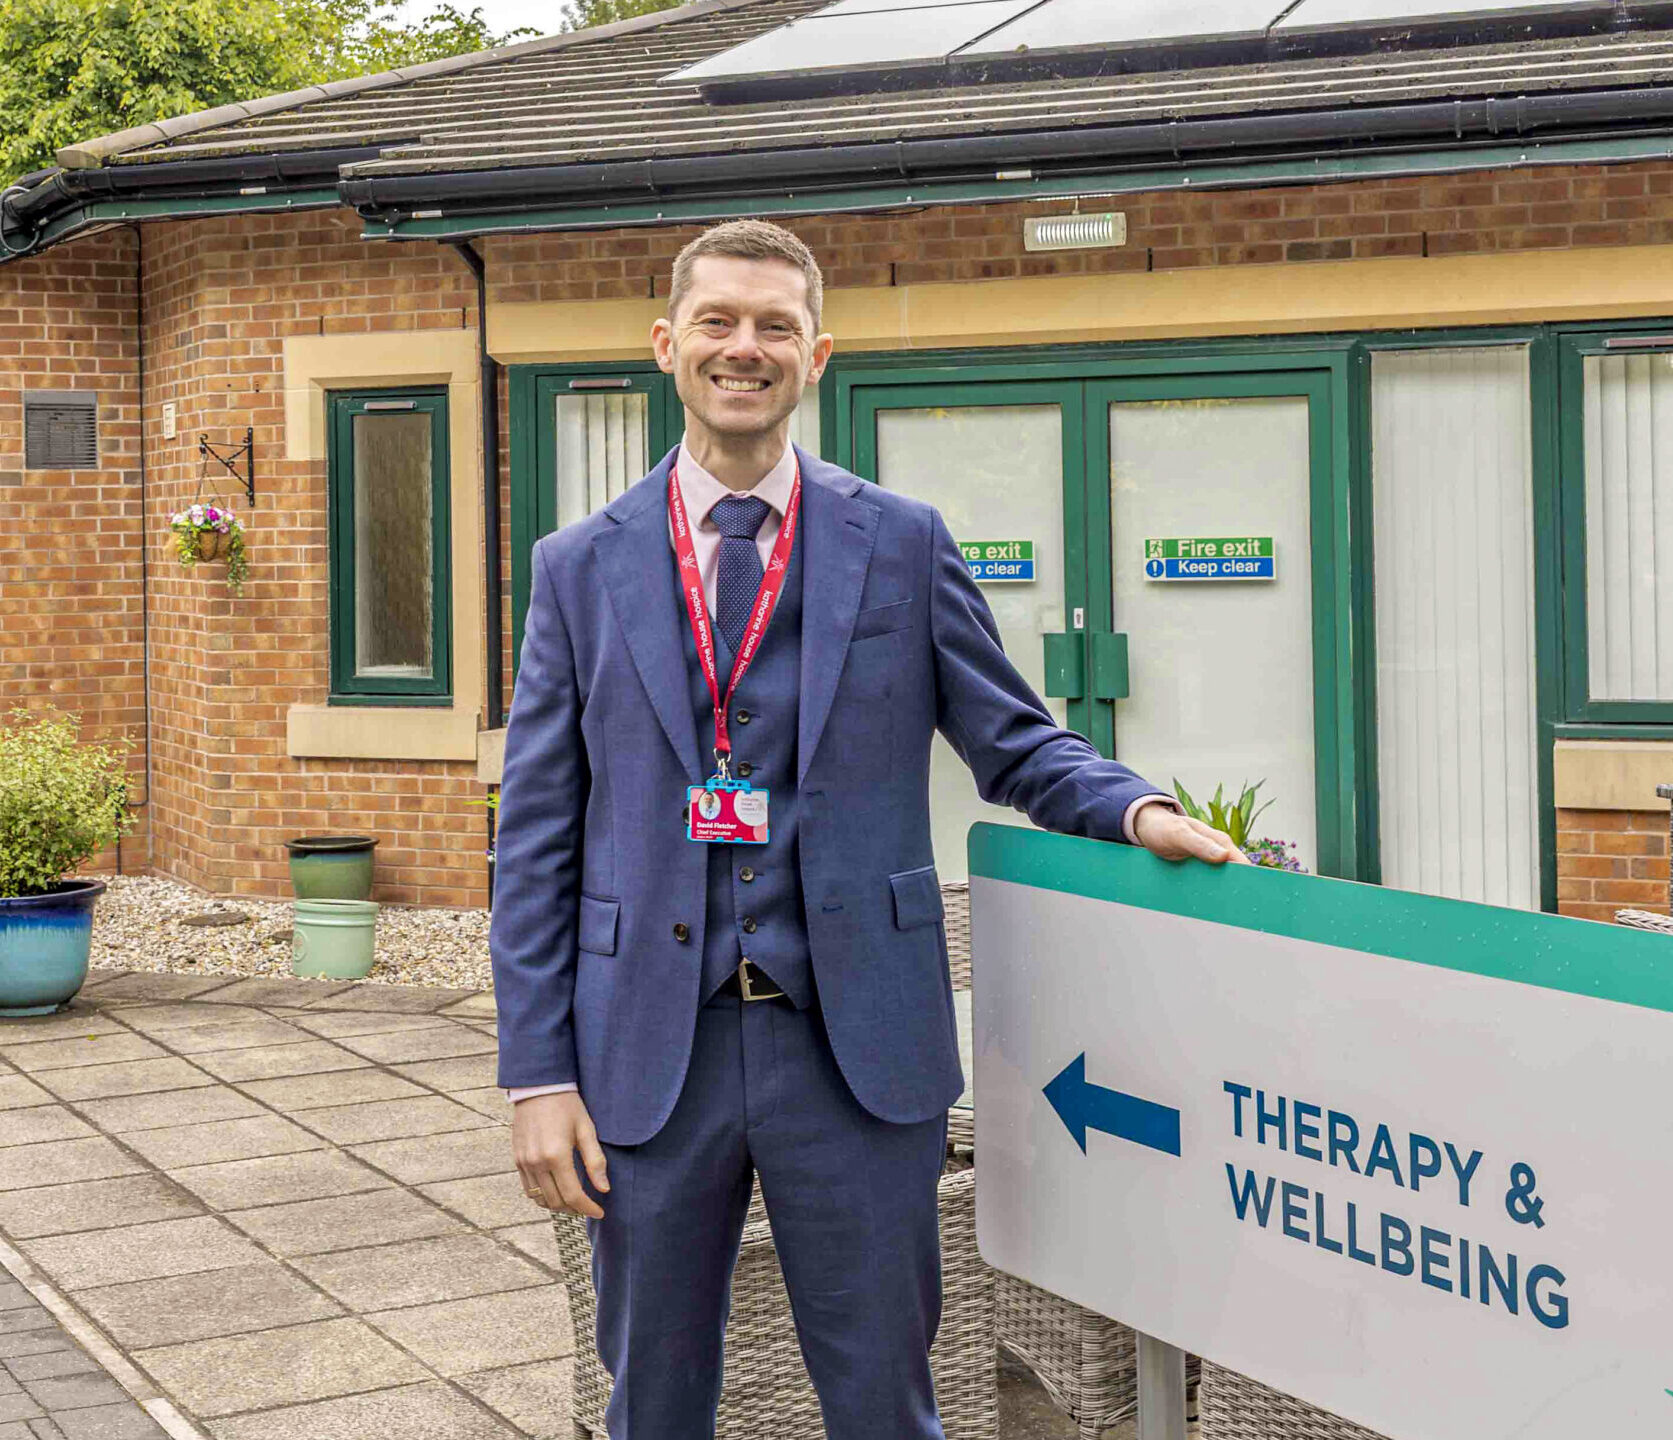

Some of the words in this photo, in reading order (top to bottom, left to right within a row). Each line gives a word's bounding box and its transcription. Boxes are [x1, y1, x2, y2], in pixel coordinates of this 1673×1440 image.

[957, 545, 980, 559] re
[986, 542, 1021, 559] exit
[1177, 540, 1217, 556] Fire
[1222, 538, 1261, 556] exit
[985, 562, 1021, 575] clear
[1178, 560, 1218, 576] Keep
[1222, 560, 1261, 573] clear
[690, 586, 703, 619] hospice
[753, 590, 773, 631] katharine
[698, 620, 709, 648] house
[743, 632, 759, 658] house
[1223, 1080, 1484, 1207] THERAPY
[1505, 1162, 1546, 1229] &
[1225, 1162, 1570, 1329] WELLBEING
